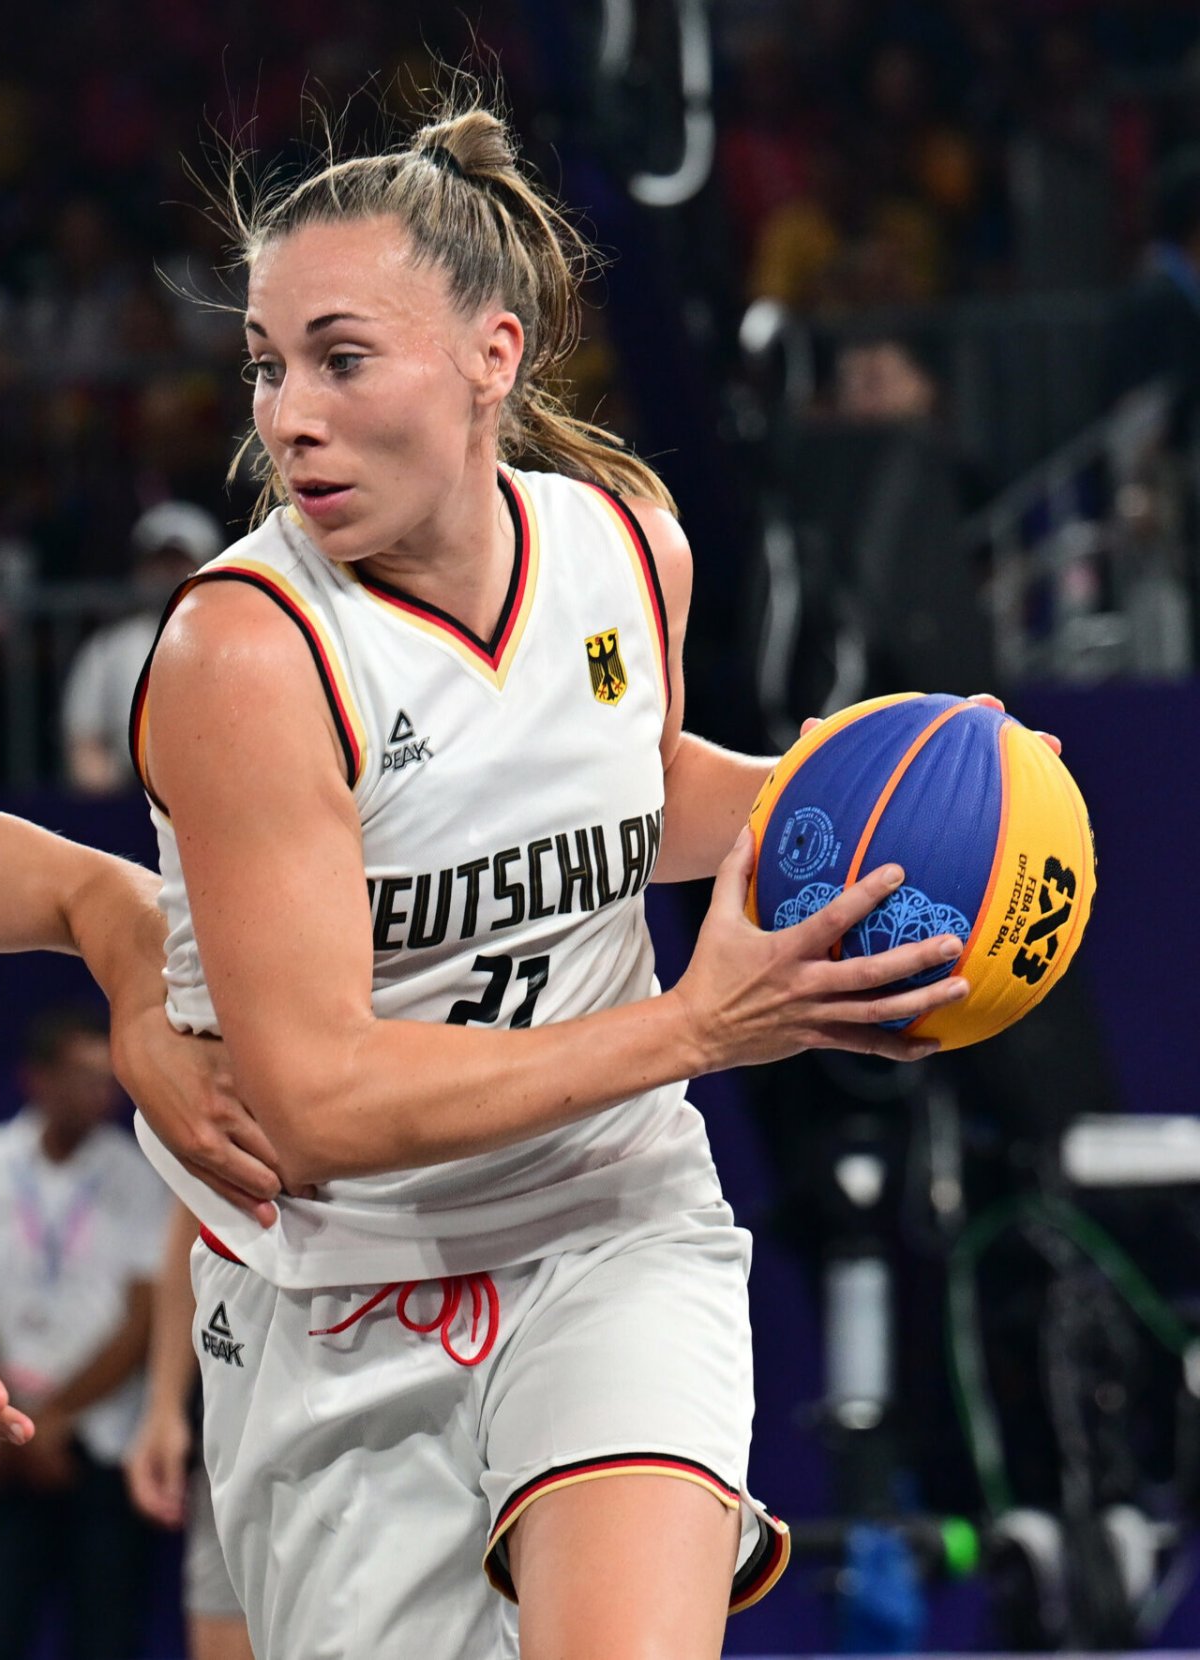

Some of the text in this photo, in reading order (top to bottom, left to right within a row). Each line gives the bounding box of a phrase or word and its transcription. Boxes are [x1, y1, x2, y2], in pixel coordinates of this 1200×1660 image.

[366, 806, 663, 950] EUTSCHLAN
[987, 853, 1027, 958] OFFICIAL BALL
[1009, 876, 1037, 945] FIBA 3x3
[201, 1328, 245, 1368] PEAK
